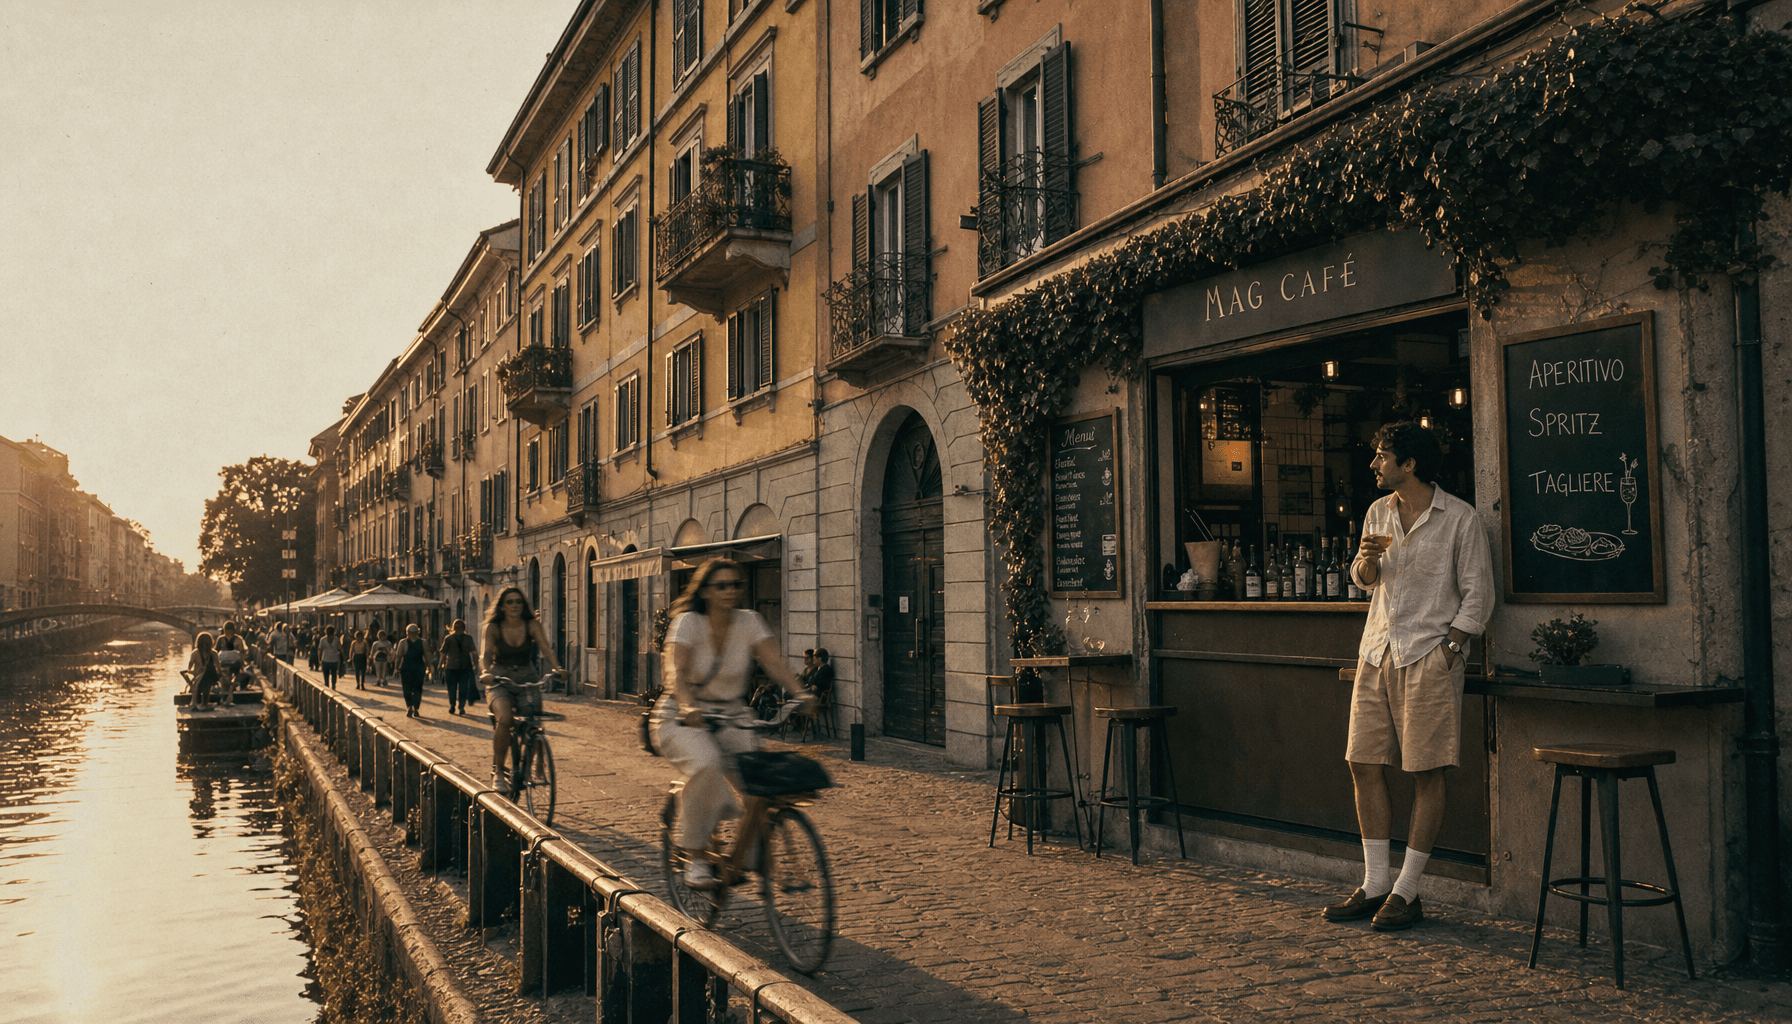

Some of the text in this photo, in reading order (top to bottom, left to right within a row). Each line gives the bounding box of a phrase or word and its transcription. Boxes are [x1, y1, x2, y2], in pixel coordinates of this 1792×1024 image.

[1205, 252, 1357, 321] MAG CAFÉ
[1529, 358, 1624, 389] APERITIVO
[1528, 407, 1603, 437] SPRITZ
[1528, 470, 1616, 496] TAGLIERE
